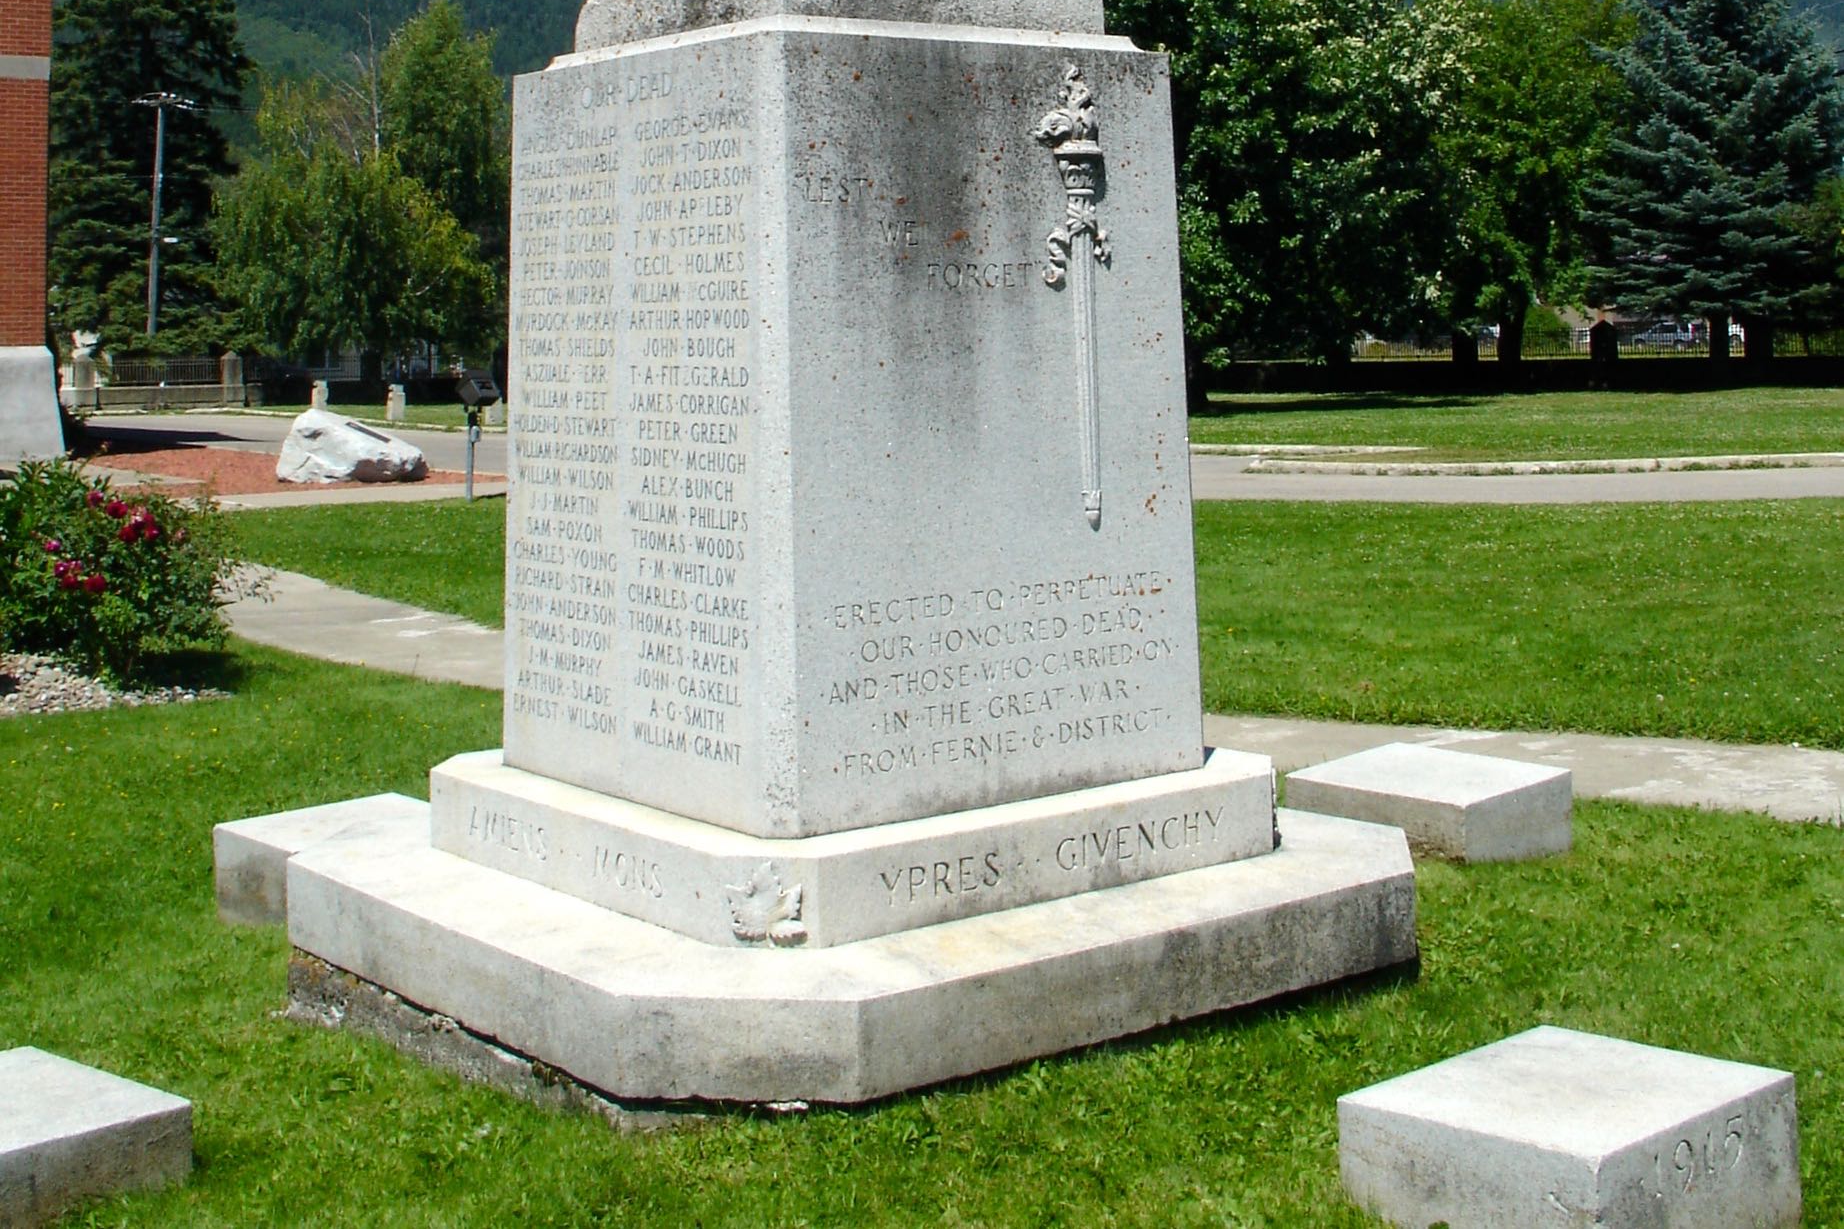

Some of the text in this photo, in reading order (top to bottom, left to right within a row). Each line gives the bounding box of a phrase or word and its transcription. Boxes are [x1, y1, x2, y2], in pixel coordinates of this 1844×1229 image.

[581, 72, 673, 109] OUR DEAD
[635, 110, 750, 141] GEORGE EVANS
[640, 136, 742, 168] JOHN T DIXON
[520, 180, 616, 206] THOMAS MARTIN
[631, 164, 752, 196] JOCK ANDERSON
[517, 210, 561, 232] STEWART
[638, 200, 672, 223] JOHN
[519, 231, 615, 257] JOSEPH LEYLAND
[632, 222, 746, 250] T W STEPHENS
[880, 220, 919, 247] WE
[523, 262, 557, 282] PETER
[634, 250, 745, 277] CECIL HOLMES
[519, 284, 614, 307] HECTOR MURRAY
[630, 281, 681, 305] WILLIAM
[515, 312, 568, 333] MURDOCK
[629, 308, 750, 331] ARTHUR HOPWOOD
[519, 337, 616, 359] THOMAS SHIELDS
[643, 337, 735, 359] JOHN BOUGH
[630, 364, 637, 386] T
[644, 365, 653, 386] A
[521, 388, 608, 411] WILLIAM PEET
[629, 392, 750, 417] JAMES CORRIGAN
[513, 413, 551, 434] HOLDEN
[564, 416, 617, 438] STEWART
[638, 419, 738, 445] PETER GREEN
[514, 438, 618, 465] WILLIAM RICHARDSON
[631, 446, 680, 470] SIDNEY
[519, 466, 614, 491] WILLIAM WILSON
[641, 474, 734, 503] ALEX BUNCH
[553, 493, 600, 516] MARTIN
[627, 500, 749, 532] WILLIAM PHILLIPS
[527, 518, 602, 543] SAM POXON
[631, 528, 745, 562] THOMAS WOODS
[513, 541, 618, 573] CHARLES YOUNG
[639, 556, 736, 588] F M WHITLOW
[514, 565, 616, 600] RICHARD STRAIN
[514, 592, 617, 627] JOHN ANDERSON
[627, 583, 749, 621] CHARLES CLARKE
[834, 570, 1163, 630] ERECTED TO PERPETUATE
[519, 617, 612, 652] THOMAS DIXON
[628, 610, 749, 651] THOMAS PHILLIPS
[861, 607, 1143, 663] OUR HONOURED DEAD
[529, 645, 603, 677] J M MURPHY
[638, 639, 740, 677] JAMES RAVEN
[828, 637, 1174, 705] AND THOSE WHO CARRIED ON
[517, 669, 613, 708] ARTHUR SLADE
[634, 667, 743, 708] JOHN GASKELL
[513, 692, 618, 735] ERNEST WILSON
[649, 698, 725, 734] A G SMITH
[883, 678, 1130, 735] IN THE GREAT WAR
[633, 719, 743, 766] WILLIAM GRANT
[844, 707, 1165, 779] FROM FERNIE & DISTRICT
[470, 805, 664, 899] AMIENS MONS
[879, 805, 1225, 907] YPRES GIVENCHY
[1653, 1114, 1744, 1199] 1915
